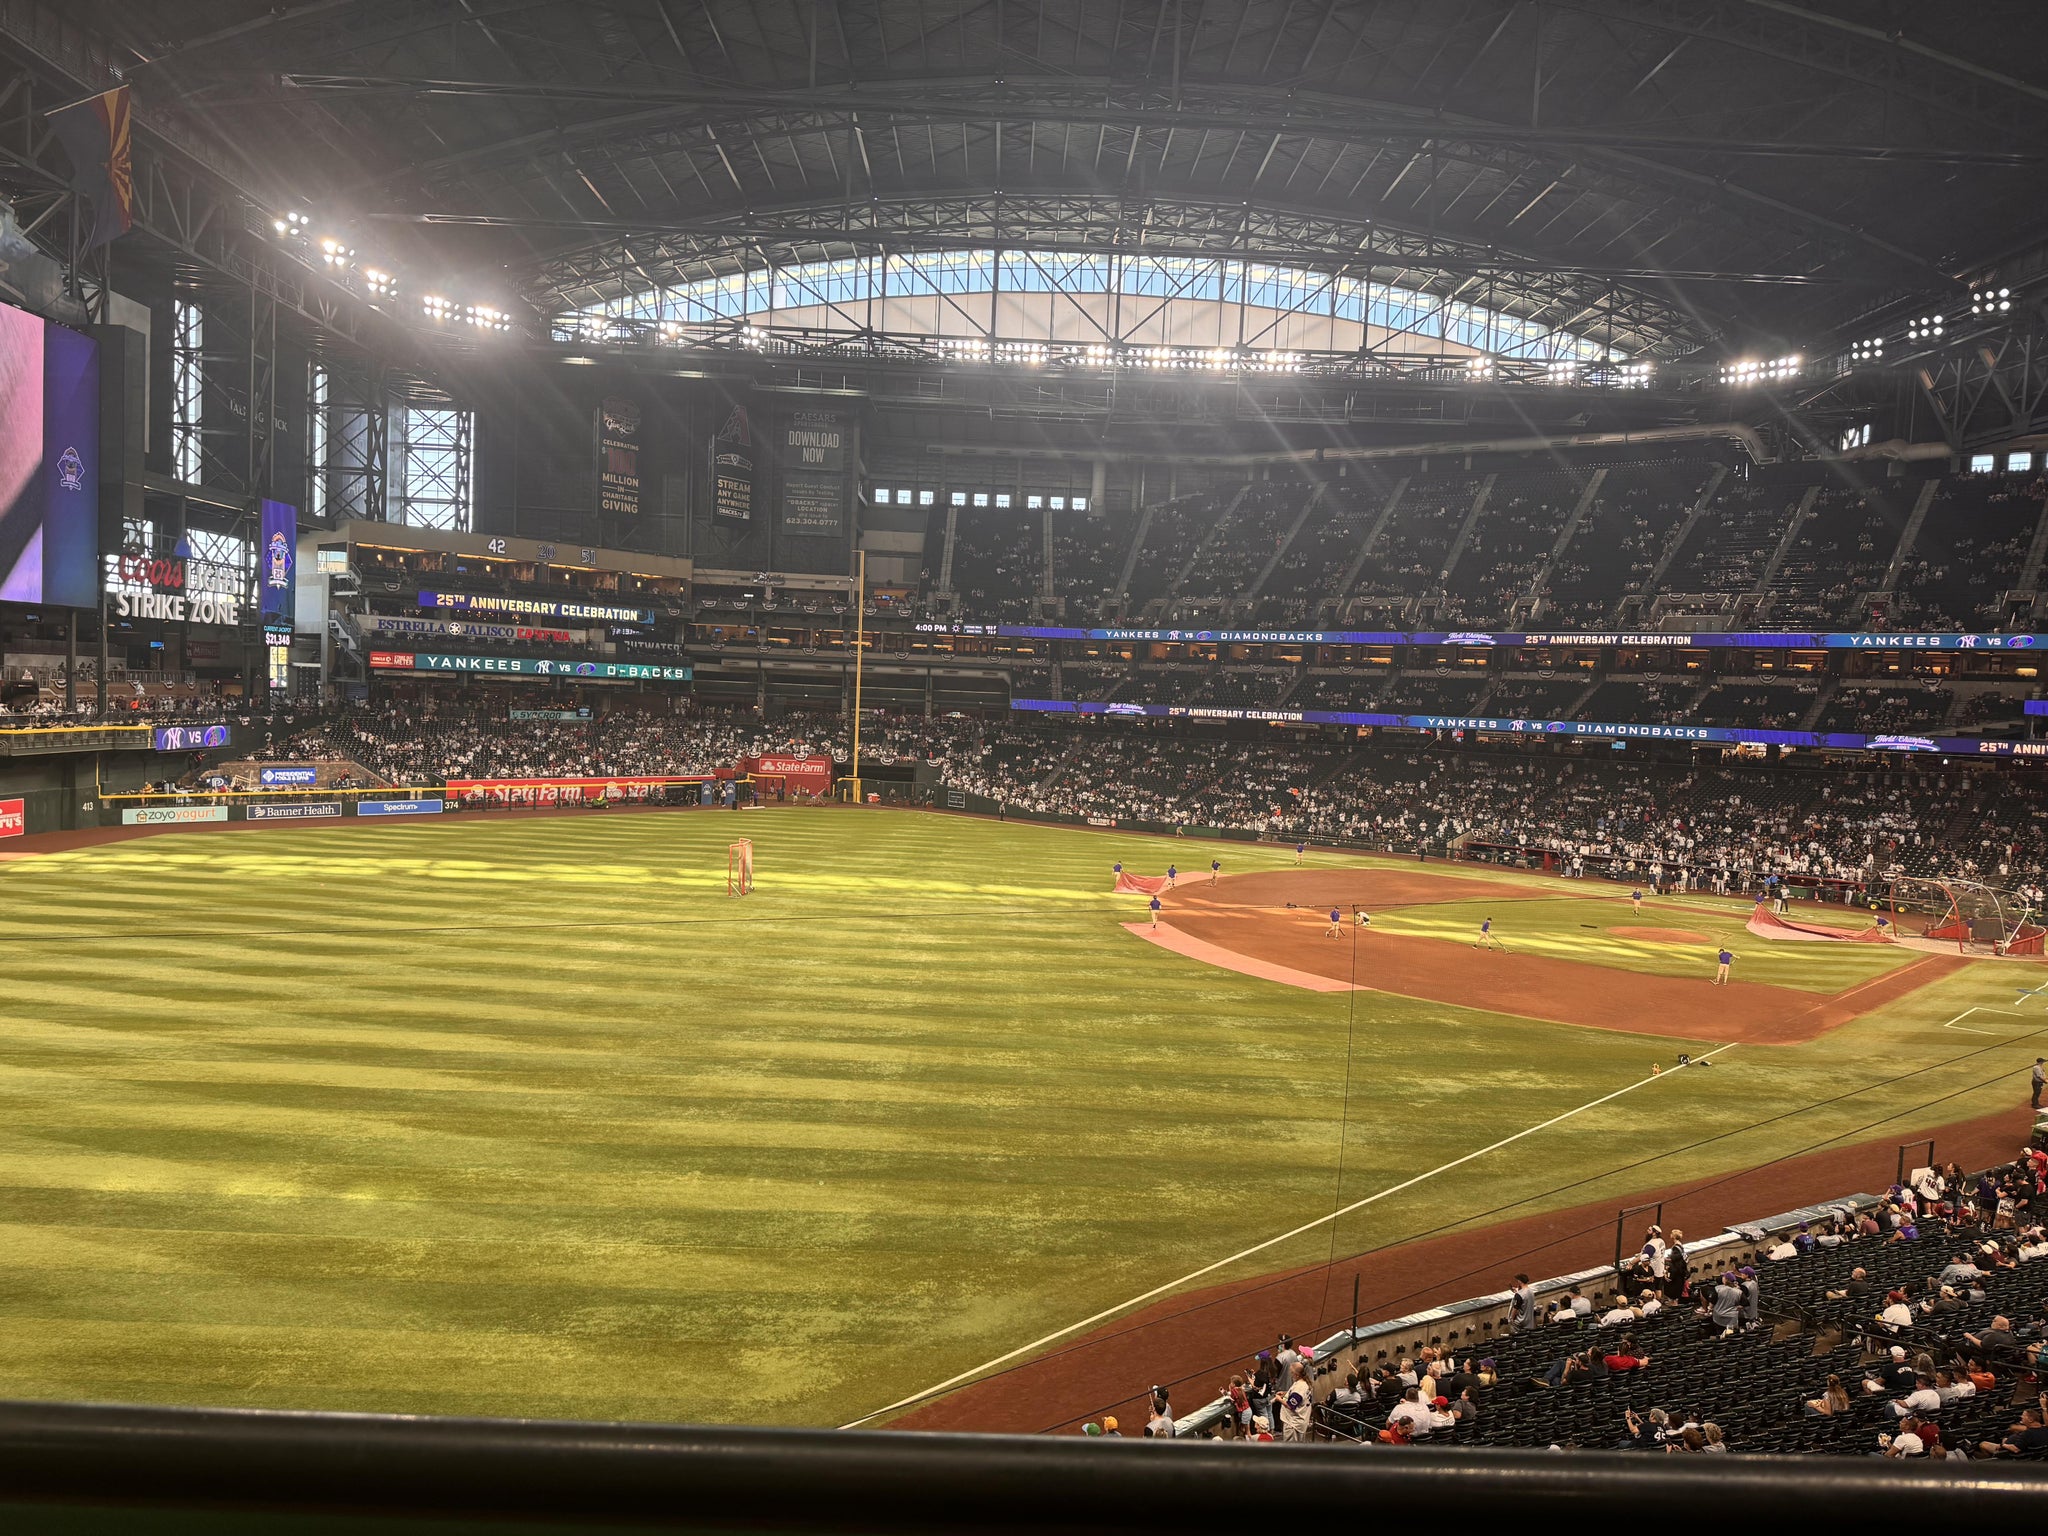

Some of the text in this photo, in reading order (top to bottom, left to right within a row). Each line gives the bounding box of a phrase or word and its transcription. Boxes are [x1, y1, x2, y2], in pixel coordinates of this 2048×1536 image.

[793, 411, 837, 424] CAESARS
[603, 438, 640, 452] CELEBRATING
[787, 430, 840, 449] DOWNLOAD
[802, 446, 825, 463] NOW
[602, 473, 639, 488] MILLION
[717, 479, 751, 494] STREAM
[617, 485, 627, 493] IN
[717, 489, 751, 502] ANY GAME
[602, 491, 639, 504] CHARITABLE
[717, 497, 751, 510] ANYWHERE
[602, 499, 639, 515] GIVING
[797, 506, 828, 514] LOCATION
[488, 538, 506, 555] 42
[537, 545, 556, 560] 20
[581, 549, 596, 565] 51
[118, 553, 239, 596] Coors LIGHT
[115, 589, 240, 626] STRIKE ZONE
[436, 593, 639, 621] 25TH ANNIVERSARY CELEBRATION
[378, 618, 446, 633] ESTRELLA
[462, 624, 515, 638] JALISCO
[1106, 630, 1160, 638] YANKEES
[1220, 632, 1323, 641] DIAMONDBACKS
[1525, 635, 1691, 645] 25TH ANNIVERSARY CELEBRATION
[1850, 636, 1941, 646] YANKEES
[428, 656, 521, 671] YANKEES
[559, 664, 571, 672] VS
[607, 665, 684, 678] D-BACKS
[1169, 707, 1303, 720] 25TH ANNIVERSARY CELEBRATION
[1428, 718, 1497, 728] YANKEES
[1577, 724, 1708, 738] DIAMONDBACKS
[189, 731, 202, 743] VS
[1875, 735, 1934, 745] World Champions
[1980, 742, 2008, 752] 25TH
[82, 802, 94, 811] 413
[267, 805, 335, 817] Banner Health
[383, 803, 415, 811] Spectrum
[444, 801, 459, 810] 374
[1925, 1178, 1936, 1188] 48
